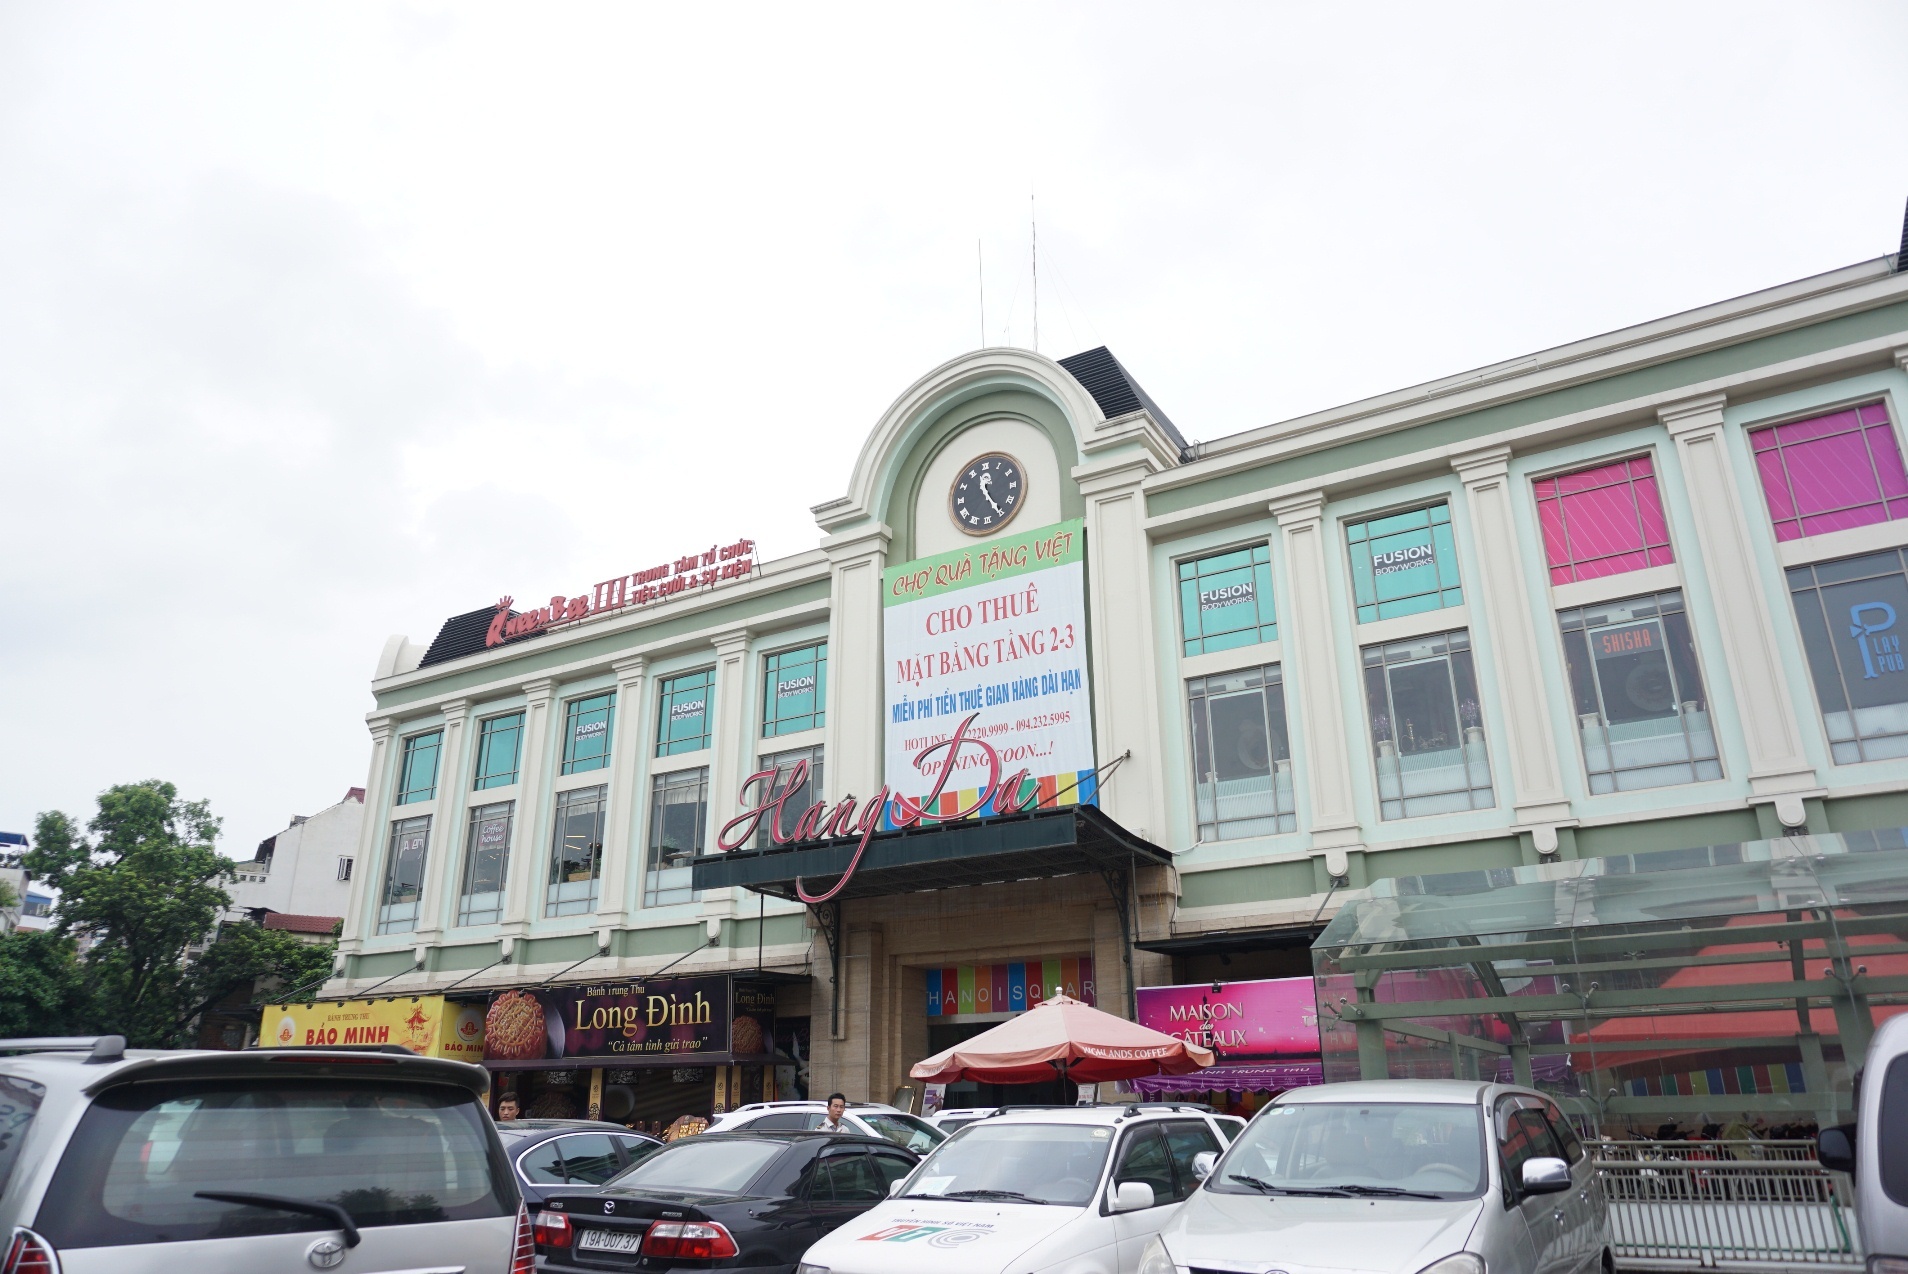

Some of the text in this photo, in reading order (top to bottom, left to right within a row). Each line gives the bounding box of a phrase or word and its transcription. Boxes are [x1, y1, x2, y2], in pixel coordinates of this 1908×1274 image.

[632, 563, 669, 587] TRUNG
[673, 555, 699, 575] TÂM
[720, 538, 753, 561] CHỨC
[892, 531, 1073, 597] CHỢ QUÀ TẶNG VIỆT
[1373, 544, 1432, 567] FUSION
[1375, 557, 1434, 576] BODYWORKS
[631, 585, 656, 605] TIỆC
[688, 574, 698, 589] &
[701, 566, 720, 588] SỰ
[721, 558, 752, 580] KIỆN
[1200, 582, 1253, 603] FUSION
[925, 582, 1040, 637] CHO THUÊ
[1201, 594, 1254, 612] BODYWORKS
[1602, 628, 1652, 654] SHISHA
[896, 653, 935, 688] MẶT
[1049, 623, 1075, 652] 2-3
[1877, 653, 1905, 674] PUB
[777, 675, 814, 692] FUSION
[892, 668, 1082, 724] MIỄN PHÍ TIỀN THUÊ GIAN HÀNG DÀI HẠN
[671, 700, 705, 715] FUSION
[576, 721, 607, 735] FUSION
[904, 733, 947, 751] HOTLINE
[1016, 710, 1071, 732] 094.232.5995
[921, 752, 990, 777] OPNING
[481, 834, 504, 844] house
[482, 823, 505, 835] Coffee
[586, 985, 606, 997] Bánh
[630, 984, 645, 995] Thu
[735, 992, 755, 1007] Long
[574, 990, 712, 1038] Long Đình
[1169, 1002, 1244, 1022] MAISON
[305, 1022, 390, 1046] BẢO MINH
[1199, 1020, 1215, 1031] des
[626, 1040, 643, 1052] tâm
[645, 1039, 662, 1051] tình
[1134, 1047, 1169, 1059] COFFEE
[583, 1230, 638, 1250] 19A-007.37
